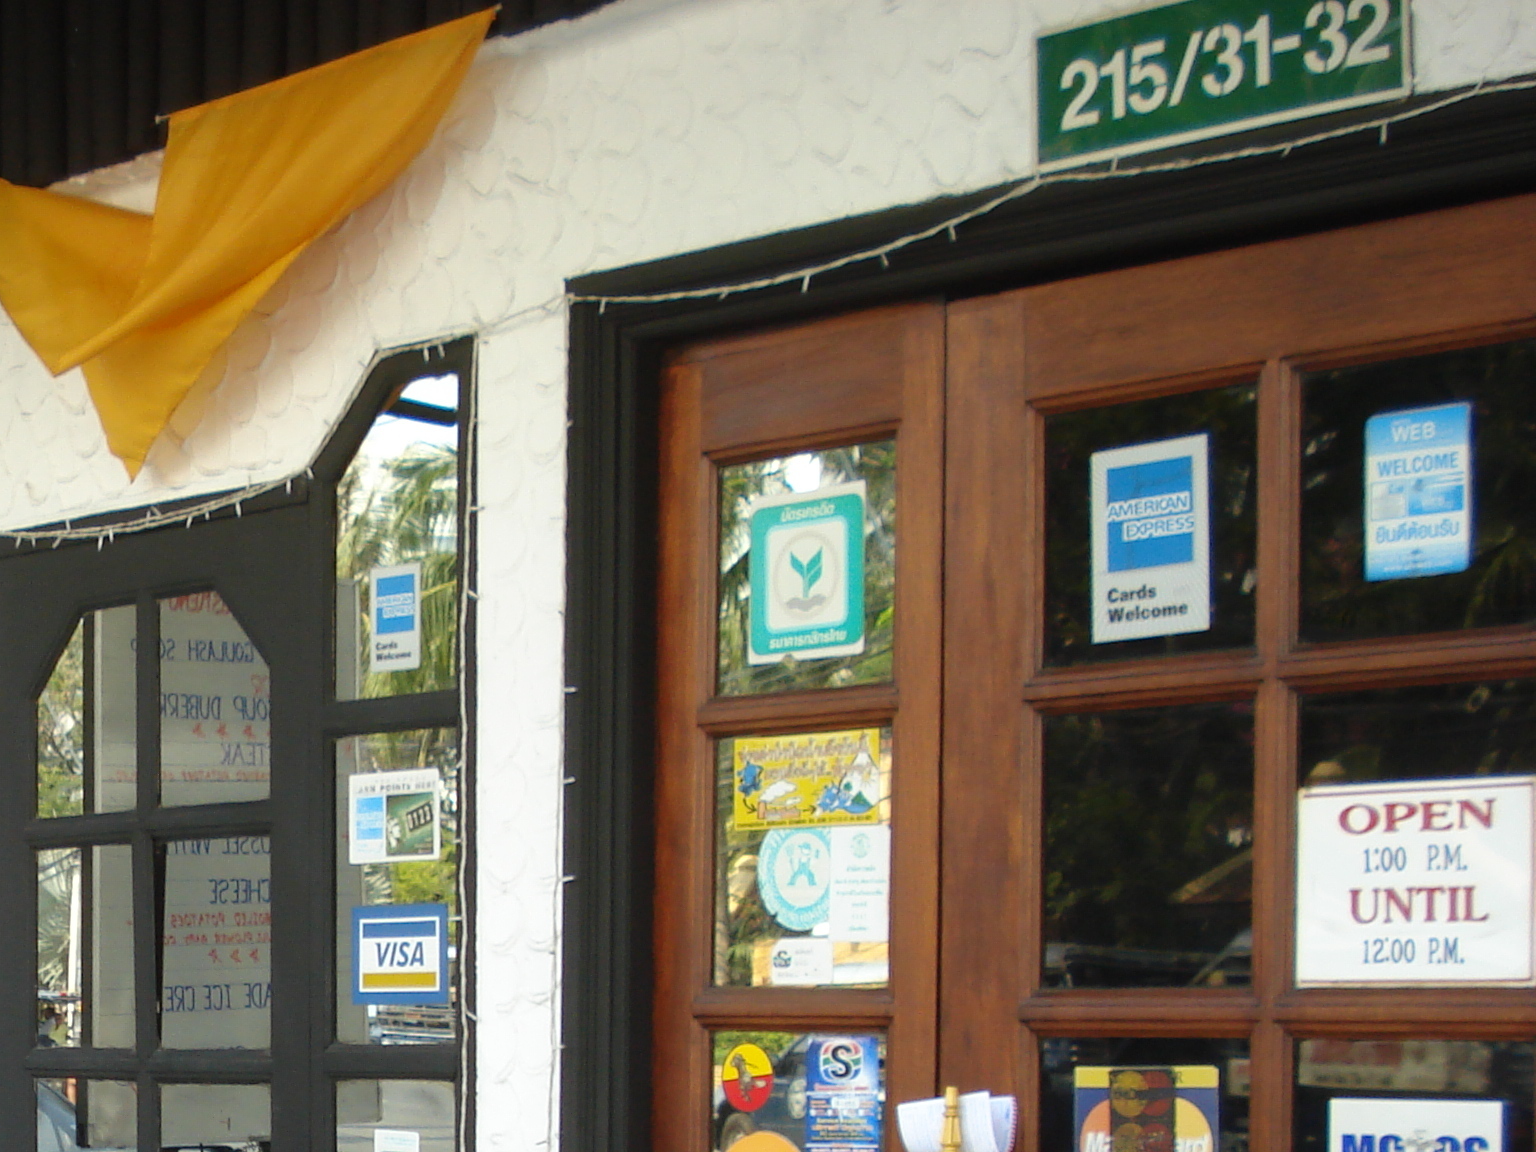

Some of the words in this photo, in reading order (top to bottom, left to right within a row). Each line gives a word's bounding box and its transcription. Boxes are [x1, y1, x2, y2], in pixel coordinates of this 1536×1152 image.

[1060, 0, 1390, 132] 215/31-32
[1392, 421, 1435, 442] WEB
[1377, 451, 1459, 477] WELCOME
[1108, 494, 1189, 519] AMERICAN
[1125, 515, 1195, 540] EXPRESS
[1107, 584, 1157, 603] Cards
[1108, 603, 1189, 623] Welcome
[1338, 798, 1498, 835] OPEN
[1363, 845, 1407, 874] 1:00
[1425, 843, 1469, 872] P.M.
[1348, 885, 1490, 924] UNTIL
[374, 940, 425, 968] VISA
[1362, 937, 1416, 965] 12:00
[1427, 937, 1466, 965] P.M.
